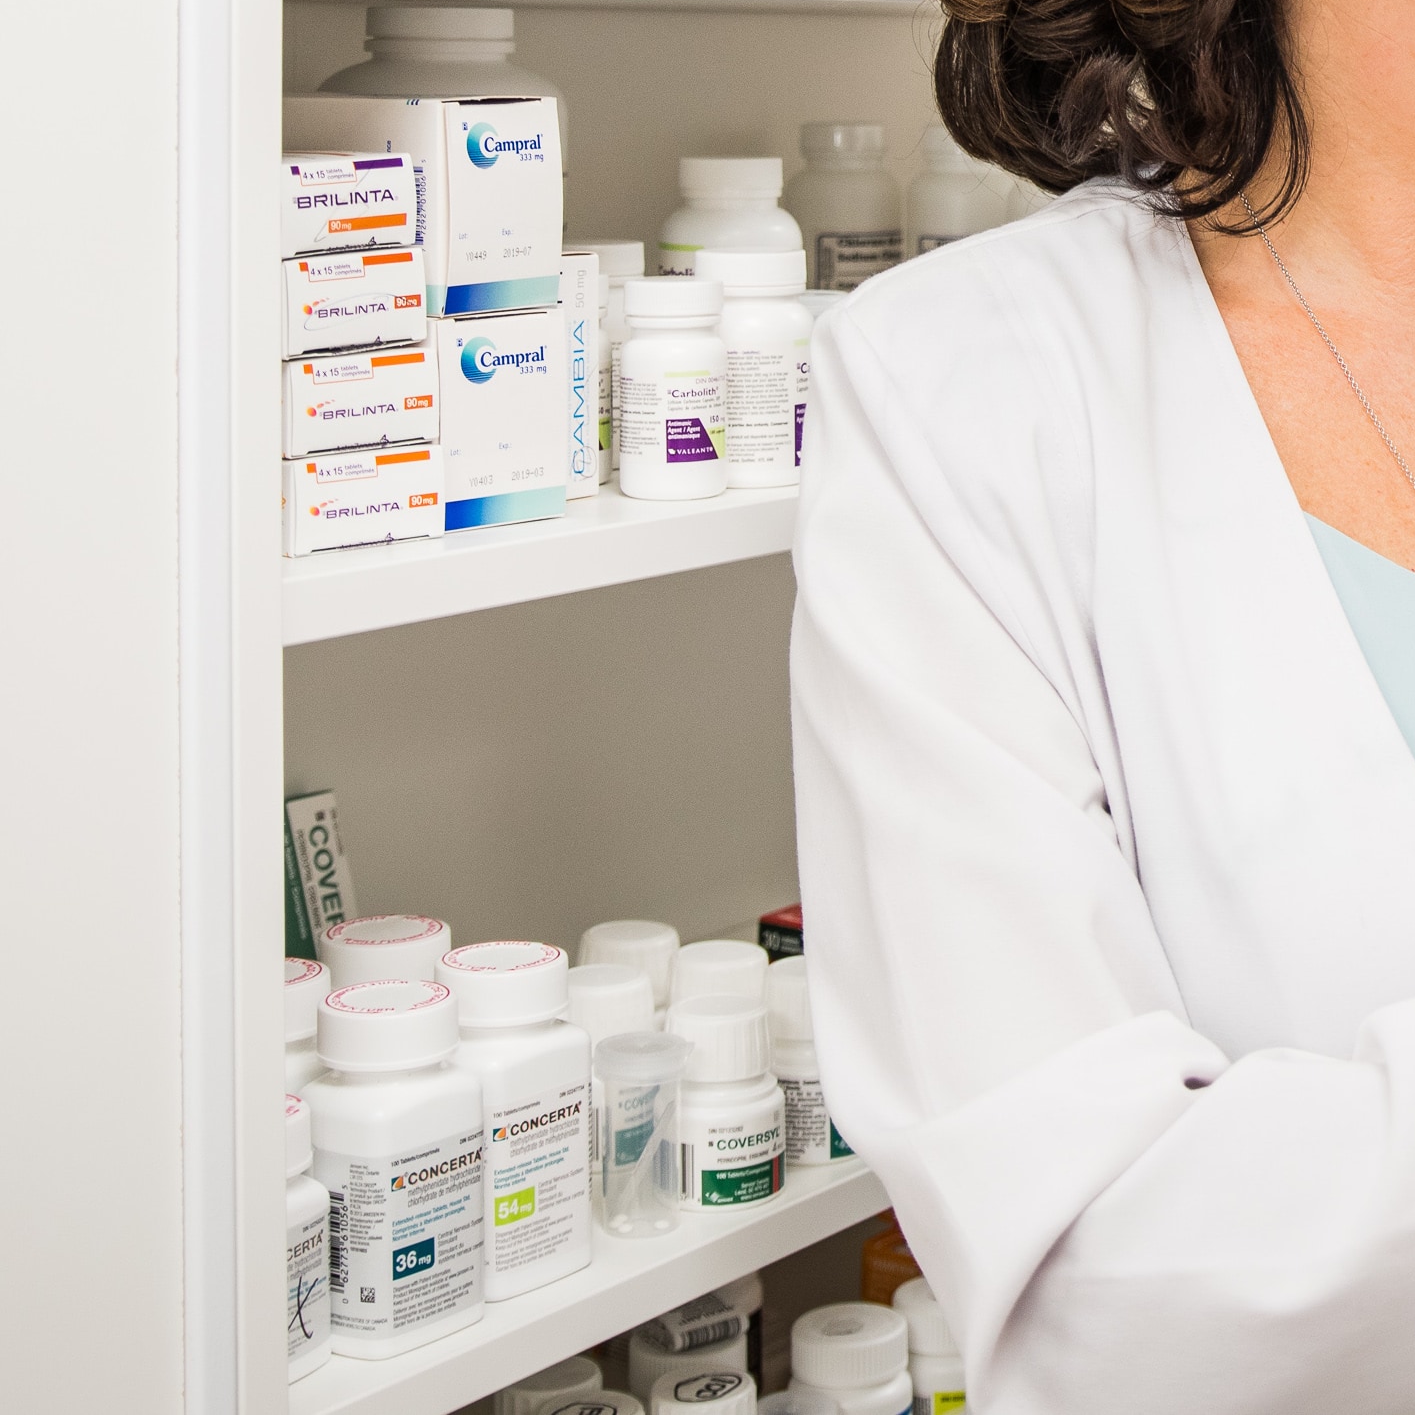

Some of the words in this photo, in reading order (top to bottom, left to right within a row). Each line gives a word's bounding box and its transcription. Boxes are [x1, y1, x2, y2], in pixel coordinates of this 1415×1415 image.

[484, 134, 541, 154] Campral
[534, 154, 544, 162] mg
[303, 172, 308, 180] 4
[316, 170, 326, 178] 15
[297, 189, 394, 209] BRILINTA
[331, 221, 341, 230] 90
[342, 222, 352, 230] mg
[503, 246, 532, 258] 2019-07
[335, 268, 361, 276] comprimés
[577, 269, 587, 288] mg
[396, 297, 406, 306] 90
[575, 293, 585, 308] 50
[318, 303, 386, 318] BRILINTA
[480, 346, 544, 367] Campral
[330, 368, 339, 376] 15
[520, 366, 533, 374] 333
[536, 366, 547, 374] mg
[573, 320, 584, 473] CAMBIA
[671, 389, 716, 398] Carbolith
[406, 398, 417, 407] 90
[417, 399, 428, 408] mg
[323, 404, 396, 419] BRILINTA
[677, 447, 710, 455] VALEANT
[333, 467, 343, 475] 15
[345, 468, 374, 476] comprimés
[469, 475, 493, 487] Y0403
[511, 467, 544, 480] 2019-03
[411, 495, 422, 505] 90
[423, 497, 433, 505] mg
[326, 502, 400, 519] BRILINTA
[510, 1103, 580, 1136] CONCERTA
[717, 1127, 780, 1150] COVERSYL
[408, 1150, 481, 1185] CONCERTA
[408, 1177, 449, 1198] methylphenidate
[408, 1191, 437, 1208] chlorhydrate
[498, 1198, 519, 1220] 54
[520, 1202, 532, 1214] mg
[392, 1210, 431, 1228] Extended-release
[409, 1227, 425, 1237] interne
[287, 1231, 322, 1261] CERTA
[340, 1247, 349, 1283] 62773
[396, 1250, 417, 1273] 36
[418, 1254, 432, 1266] mg
